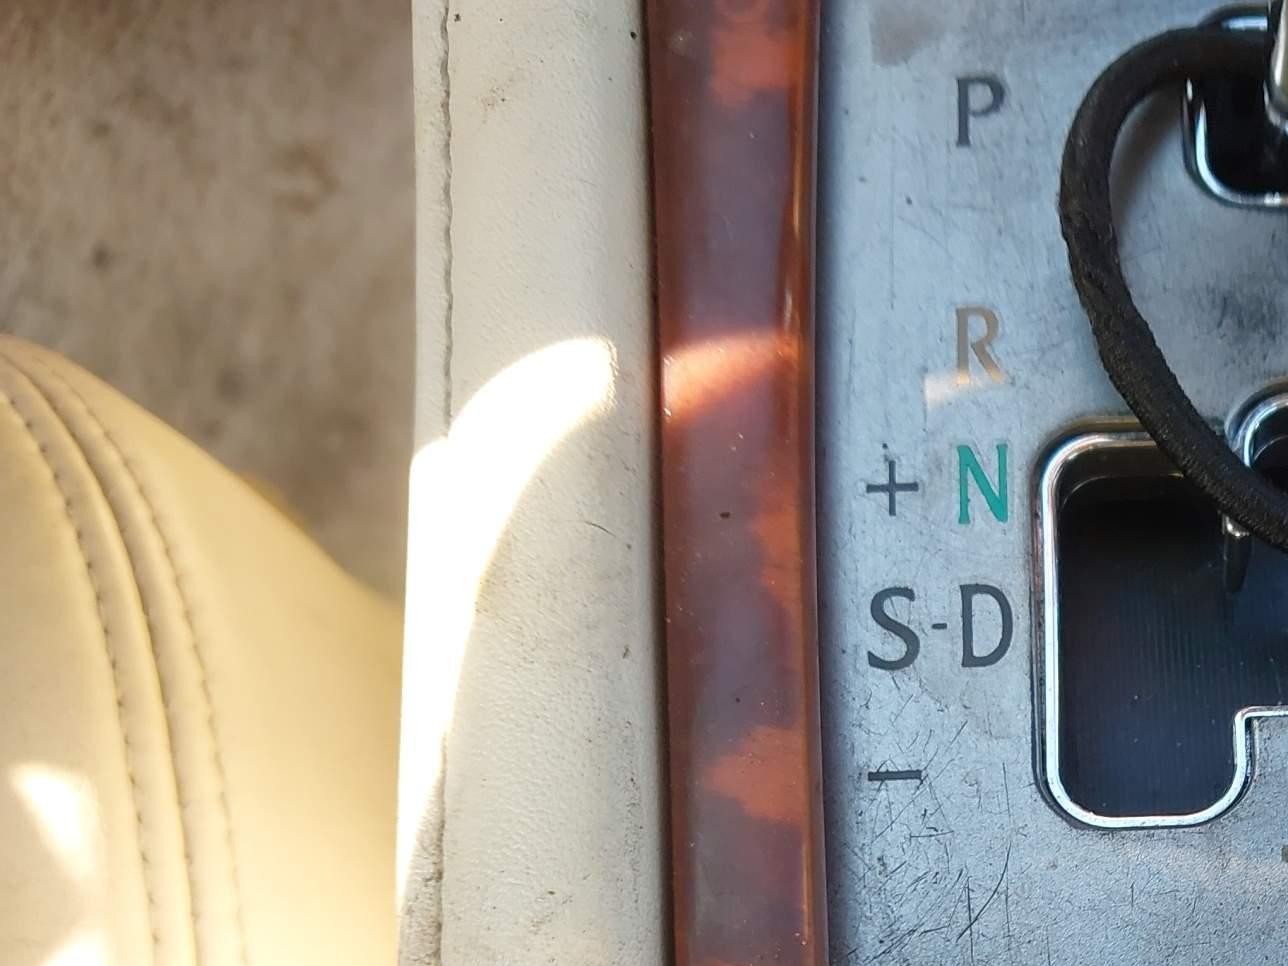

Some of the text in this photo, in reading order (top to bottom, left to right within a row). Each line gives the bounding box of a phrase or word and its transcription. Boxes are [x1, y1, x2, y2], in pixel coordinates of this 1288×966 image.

[955, 76, 1006, 147] P
[955, 305, 1004, 384] R
[956, 443, 1009, 525] N
